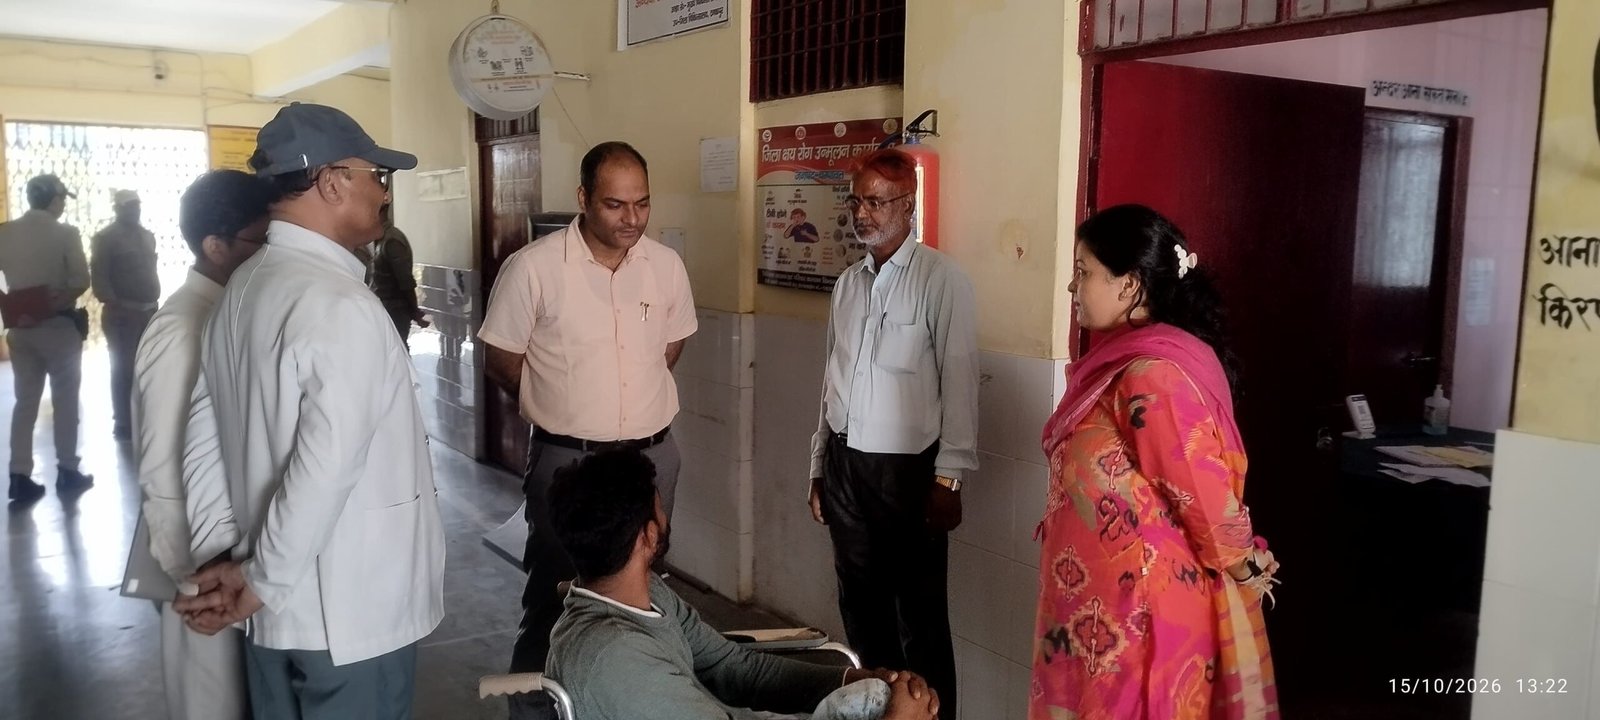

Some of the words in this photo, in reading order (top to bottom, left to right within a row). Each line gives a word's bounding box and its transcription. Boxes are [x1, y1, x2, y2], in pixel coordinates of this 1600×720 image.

[762, 144, 780, 162] जिला
[782, 147, 796, 161] क्षय
[797, 142, 813, 160] रोग
[814, 145, 850, 166] उन्मूलन
